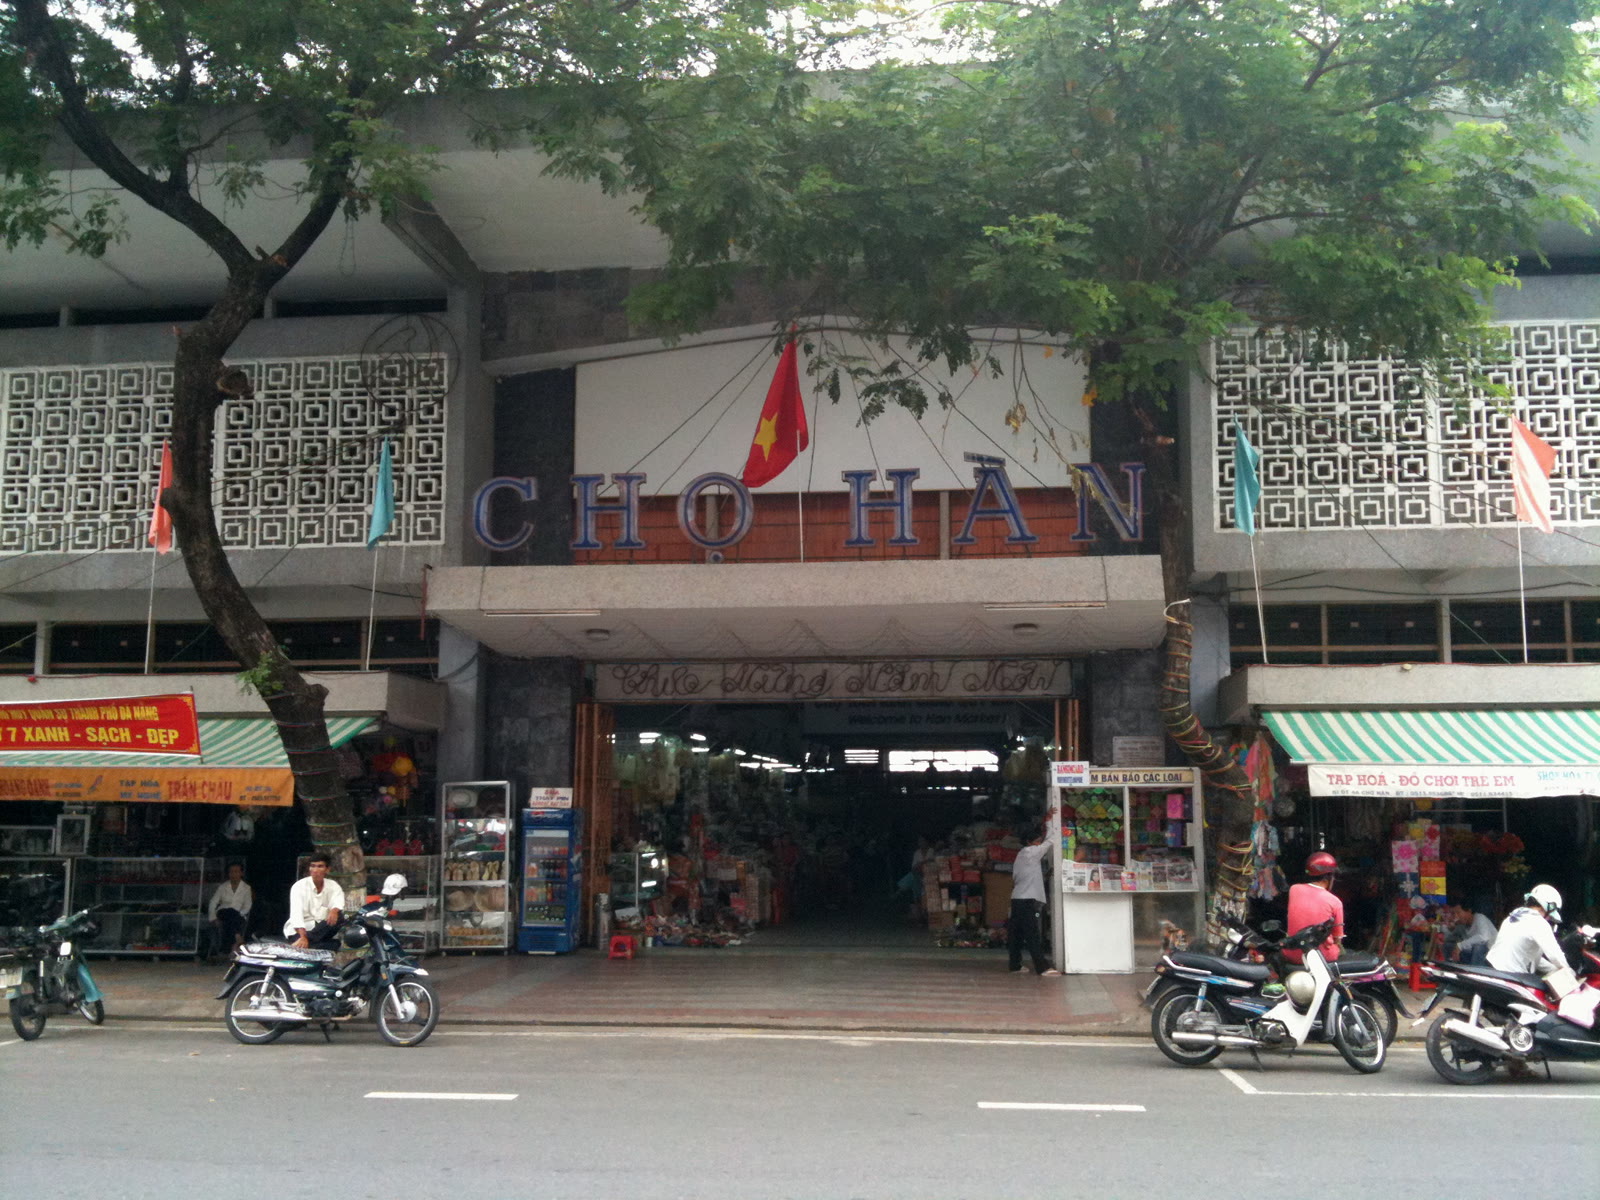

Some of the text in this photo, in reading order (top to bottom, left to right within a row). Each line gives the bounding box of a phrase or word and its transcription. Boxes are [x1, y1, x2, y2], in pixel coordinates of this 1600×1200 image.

[841, 451, 1146, 550] HÀN
[7, 727, 17, 742] 7
[22, 727, 71, 743] XANH
[85, 727, 133, 746] SẠCH
[146, 728, 179, 748] ĐẸP
[1495, 775, 1517, 788] EM
